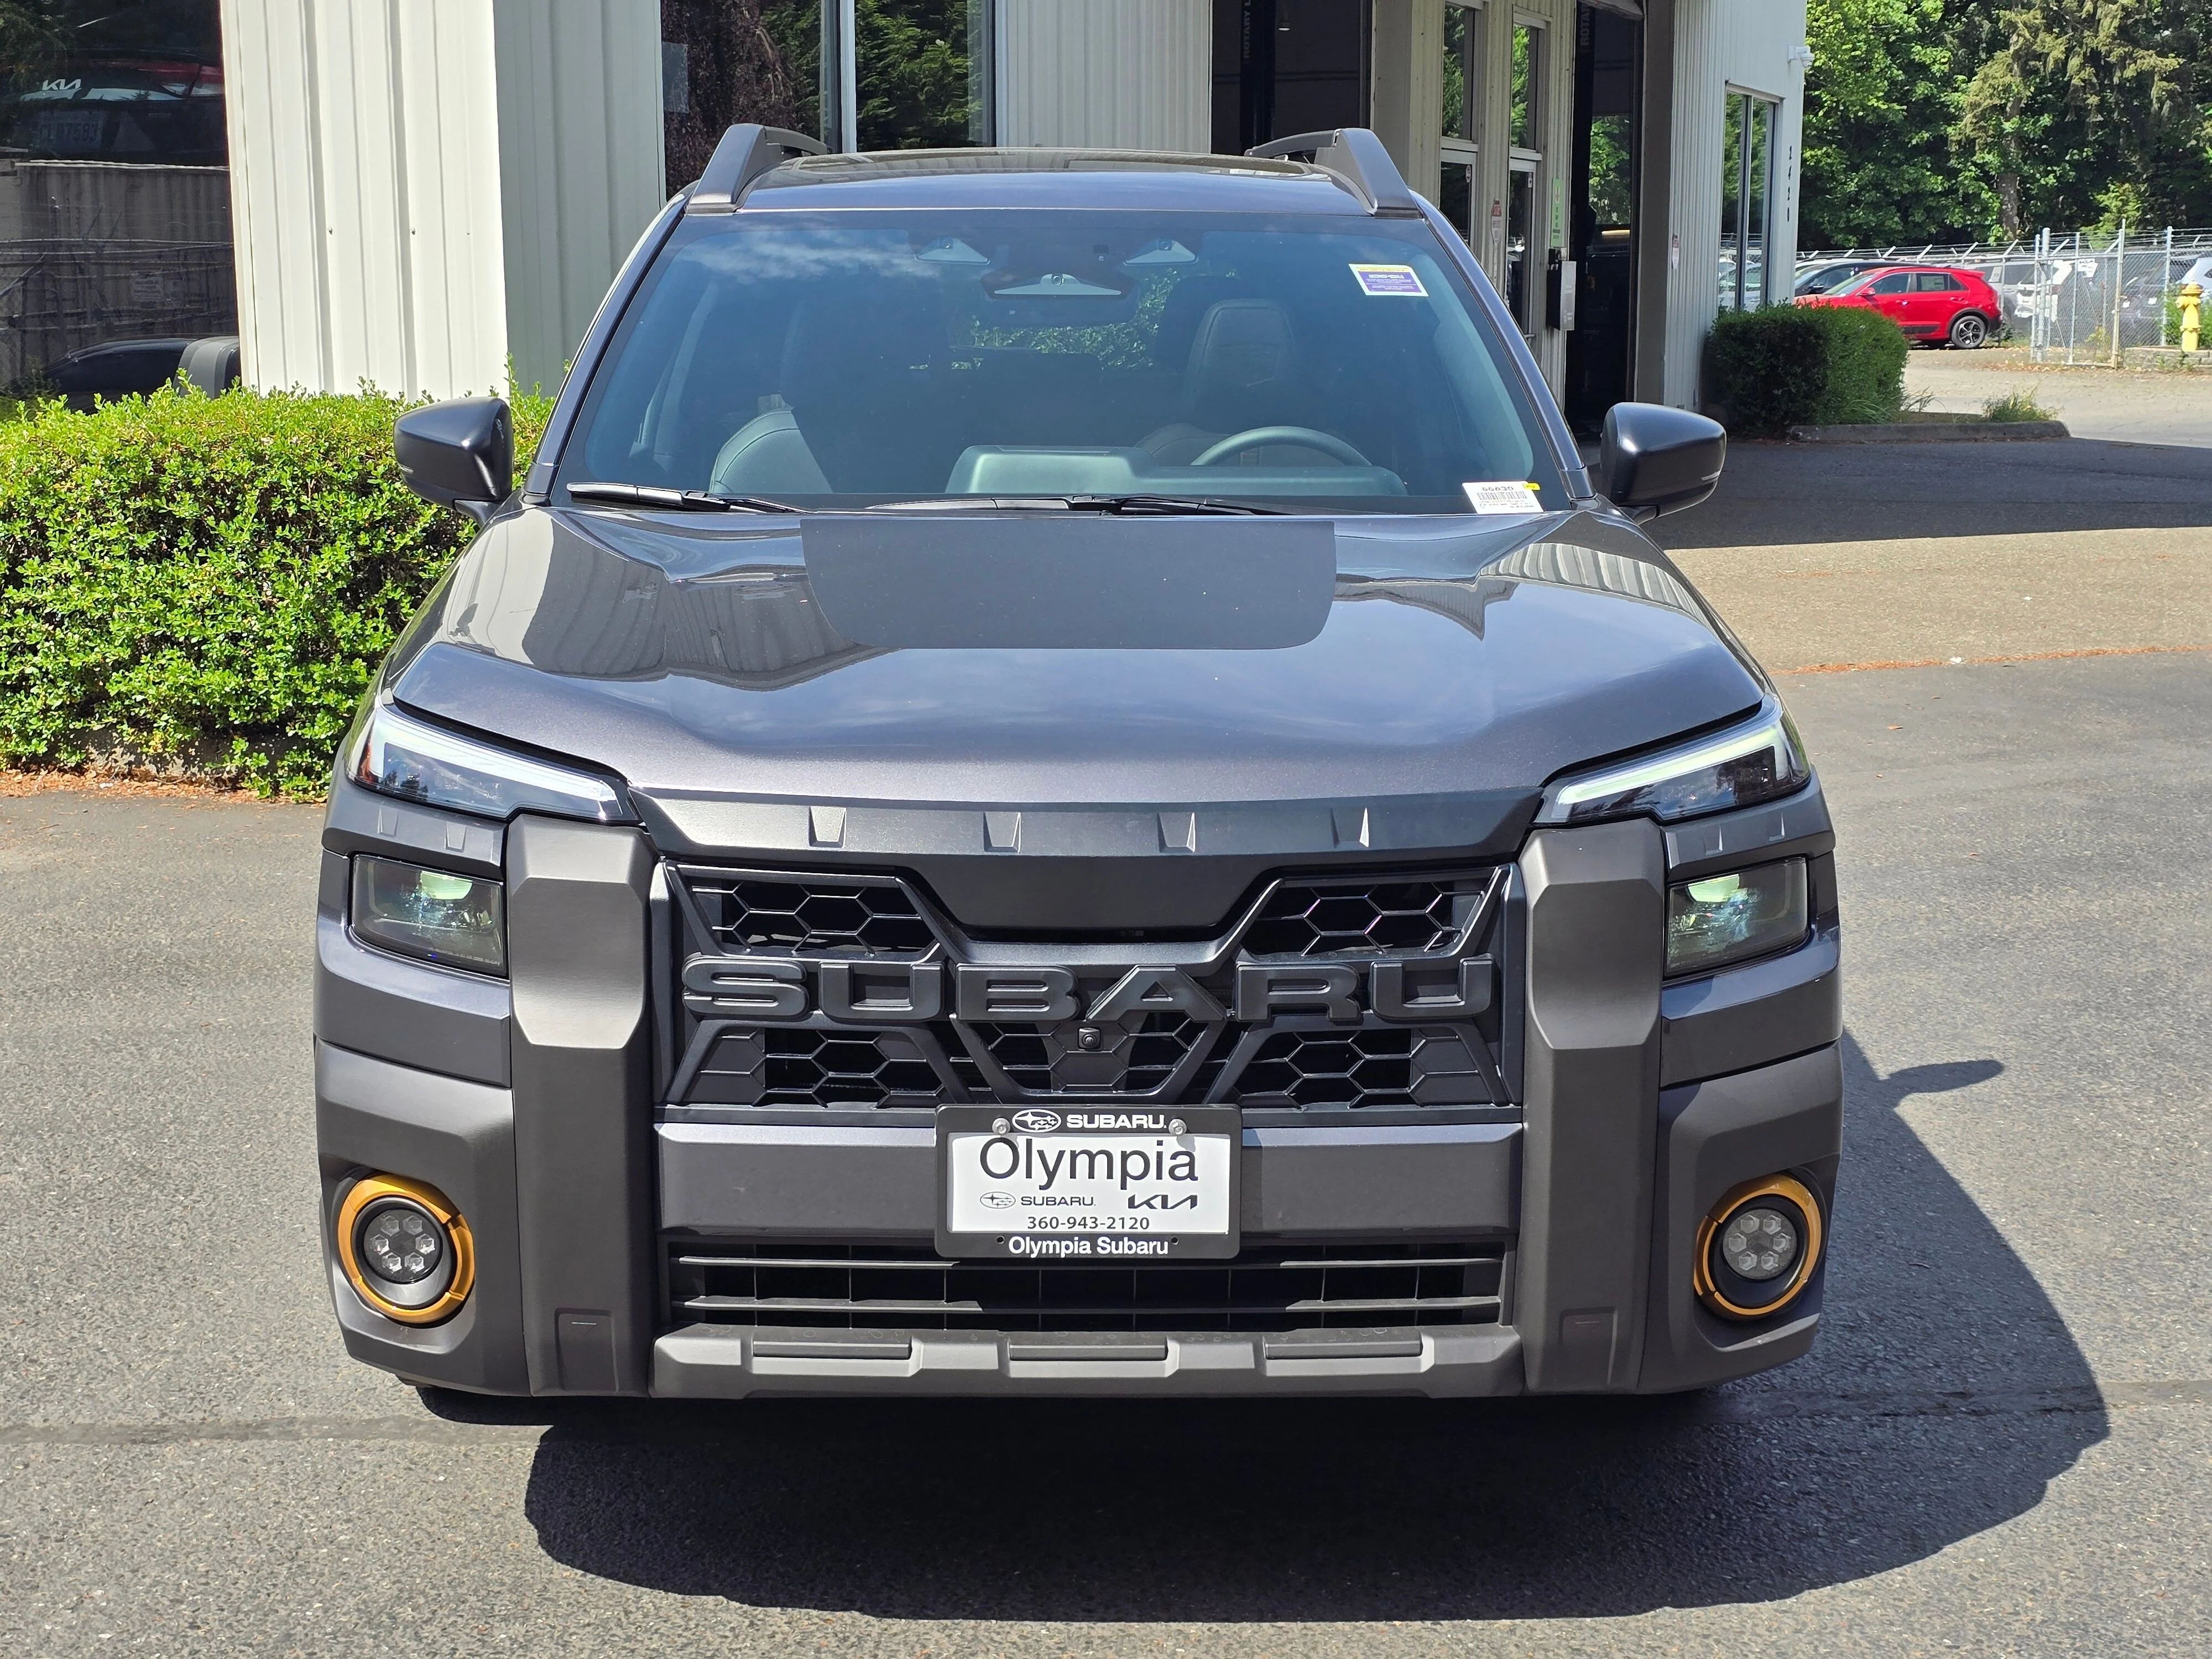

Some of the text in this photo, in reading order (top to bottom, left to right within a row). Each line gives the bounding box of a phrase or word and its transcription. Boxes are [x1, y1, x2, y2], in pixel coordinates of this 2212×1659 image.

[42, 79, 81, 90] KIA
[682, 954, 1494, 1022] SUBARU
[1067, 1114, 1163, 1129] SUBARU
[980, 1137, 1198, 1190] Olympia
[1021, 1196, 1094, 1206] SUBARU
[1027, 1217, 1150, 1229] 360-943-2120
[1008, 1236, 1168, 1258] Olympia Subaru
